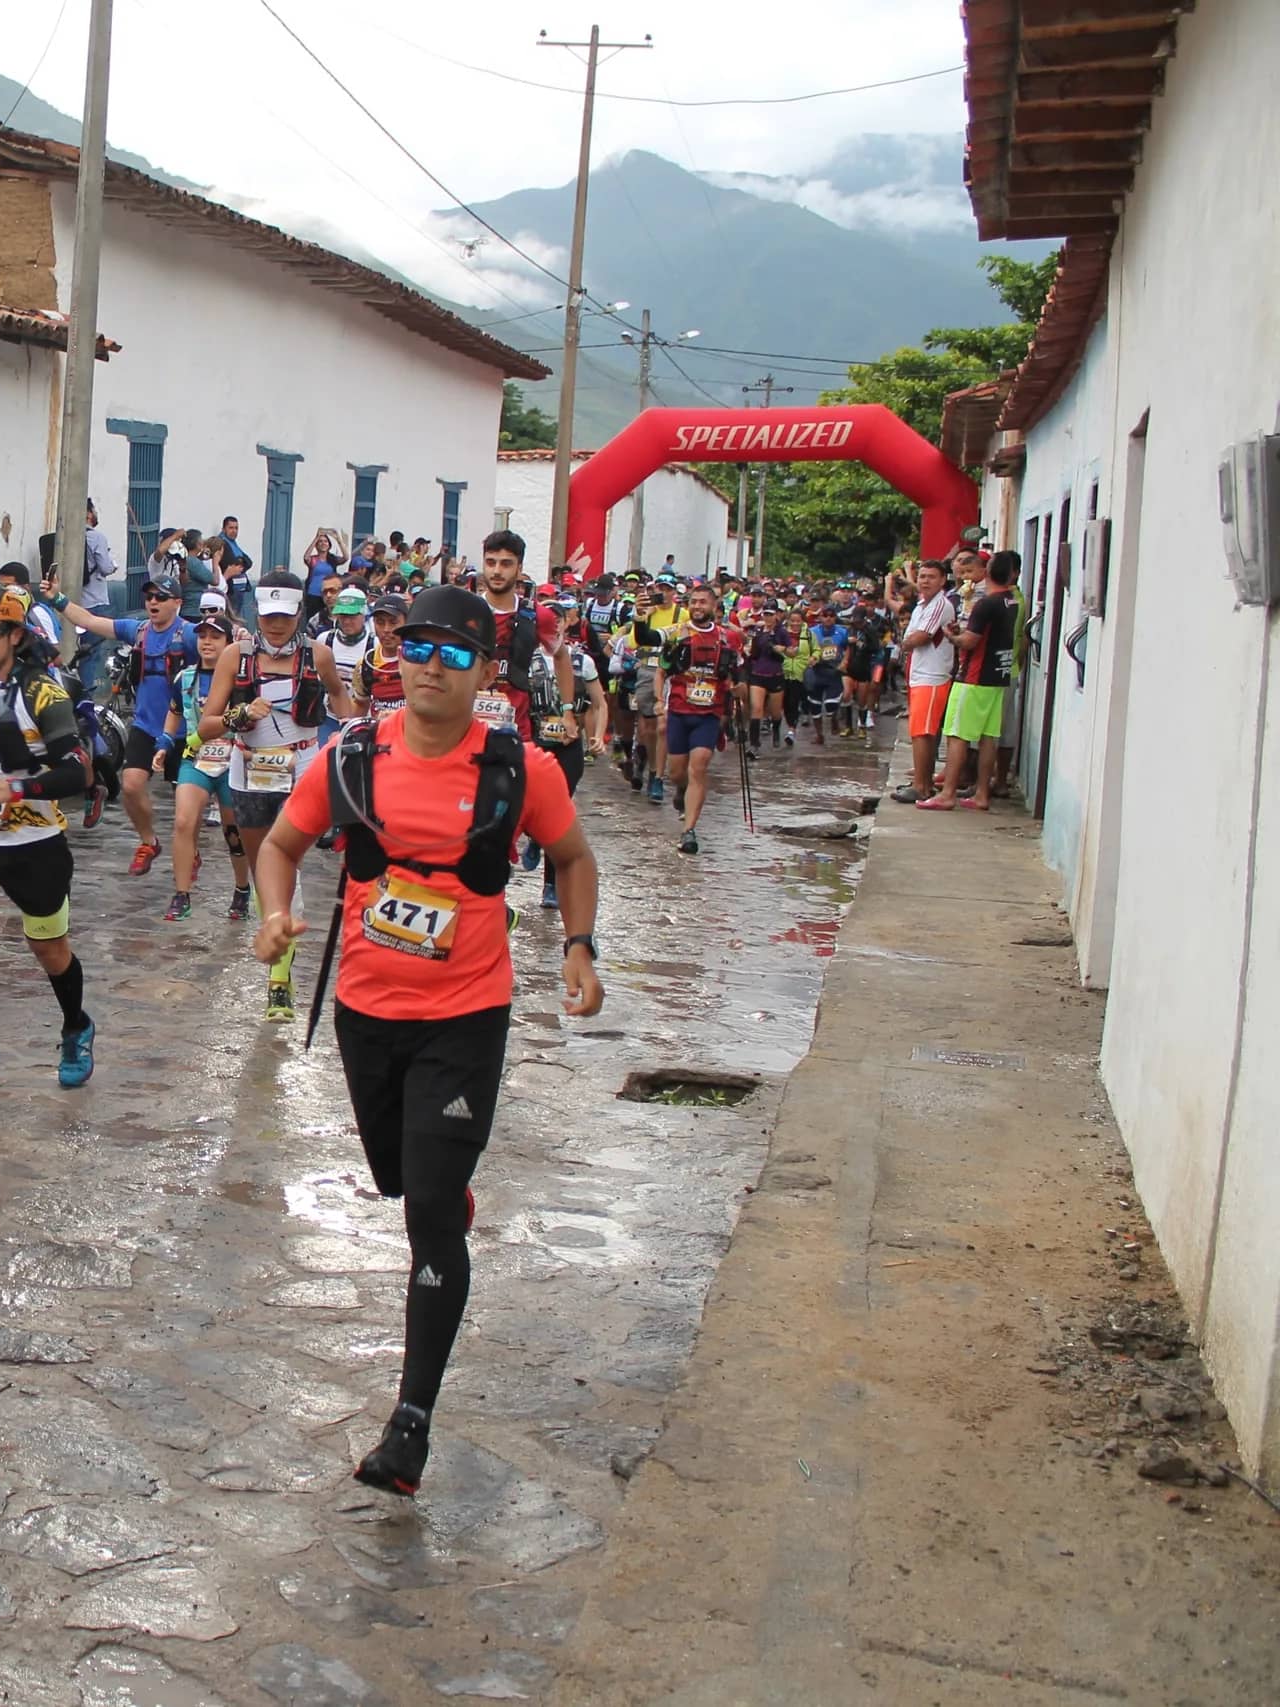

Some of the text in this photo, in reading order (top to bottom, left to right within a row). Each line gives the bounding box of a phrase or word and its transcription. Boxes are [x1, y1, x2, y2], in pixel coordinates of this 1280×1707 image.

[669, 421, 853, 450] SPECIALIZED
[477, 701, 502, 712] 564
[203, 746, 225, 756] 526
[379, 899, 439, 934] 471
